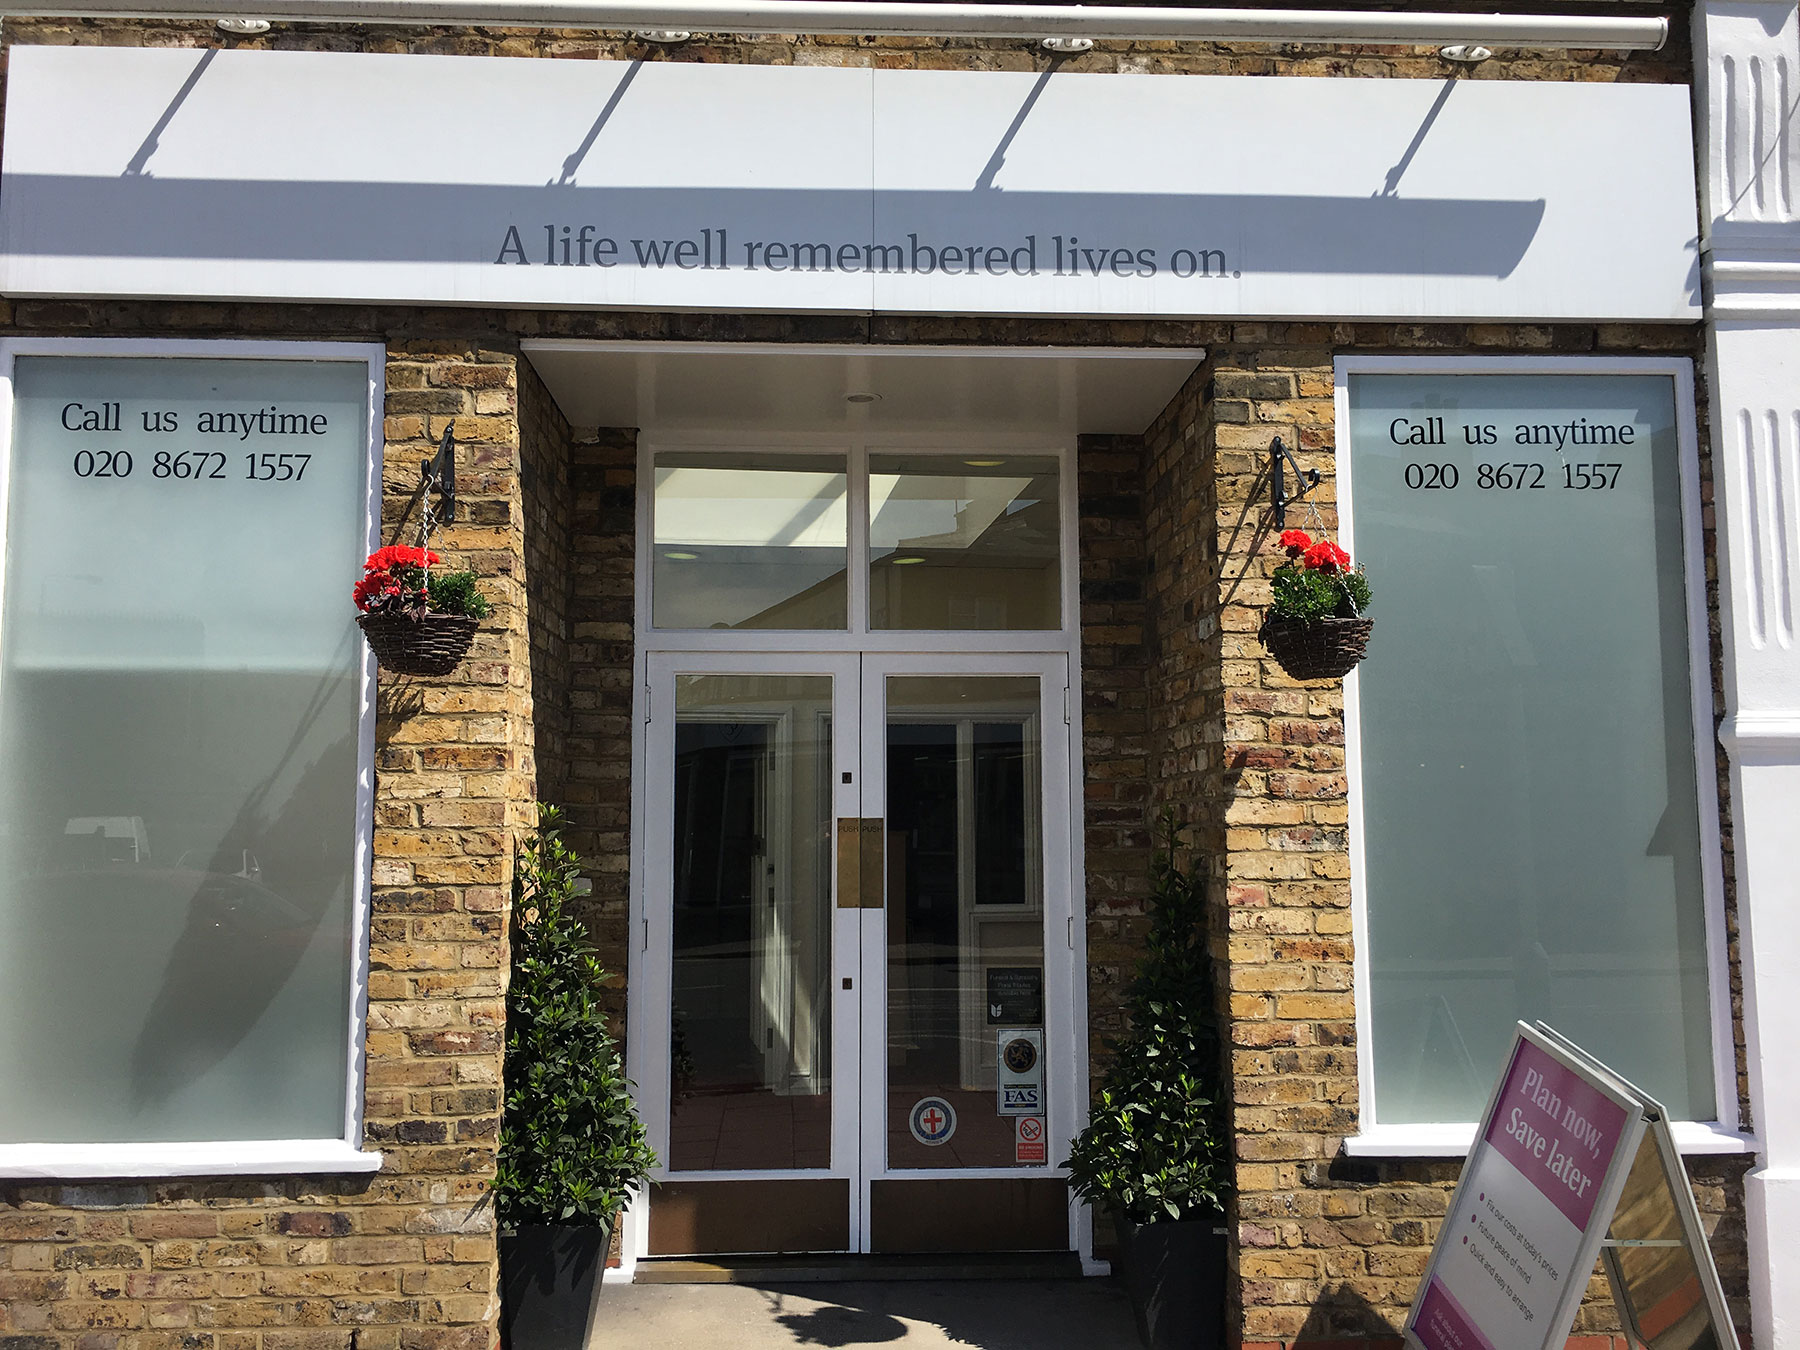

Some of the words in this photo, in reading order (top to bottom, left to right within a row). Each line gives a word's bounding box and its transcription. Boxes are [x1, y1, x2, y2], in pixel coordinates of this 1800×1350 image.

[493, 225, 531, 266] A
[543, 224, 619, 268] life
[630, 228, 731, 270] well
[743, 233, 1041, 278] remembered
[1051, 235, 1158, 278] lives
[1169, 247, 1242, 280] on.
[61, 402, 122, 432] Call
[141, 409, 179, 433] us
[197, 406, 328, 442] anytime
[1389, 416, 1447, 446] Call
[1462, 423, 1498, 446] us
[1514, 417, 1636, 453] anytime
[73, 449, 134, 479] 020
[151, 449, 227, 480] 8672
[244, 452, 312, 482] 1557
[1403, 462, 1460, 491] 020
[1476, 461, 1546, 491] 8672
[1561, 462, 1623, 491] 1557
[838, 825, 859, 833] PUSH
[862, 825, 882, 833] PUSH
[1004, 1090, 1038, 1102] FAS
[1520, 1067, 1562, 1121] Plan
[1560, 1106, 1603, 1160] now,
[1505, 1107, 1547, 1159] Save
[1544, 1138, 1592, 1198] later
[1477, 1221, 1496, 1245] Future
[1493, 1241, 1511, 1262] peace
[1509, 1258, 1519, 1269] of
[1516, 1264, 1532, 1285] mind
[1486, 1199, 1496, 1214] Fix
[1494, 1208, 1505, 1222] our
[1503, 1219, 1518, 1237] costs
[1516, 1232, 1524, 1244] at
[1522, 1238, 1542, 1264] today's
[1540, 1258, 1559, 1281] prices
[1469, 1243, 1485, 1265] Quick
[1483, 1260, 1496, 1277] and
[1493, 1272, 1508, 1291] easy
[1505, 1285, 1513, 1297] to
[1511, 1294, 1534, 1322] arrange
